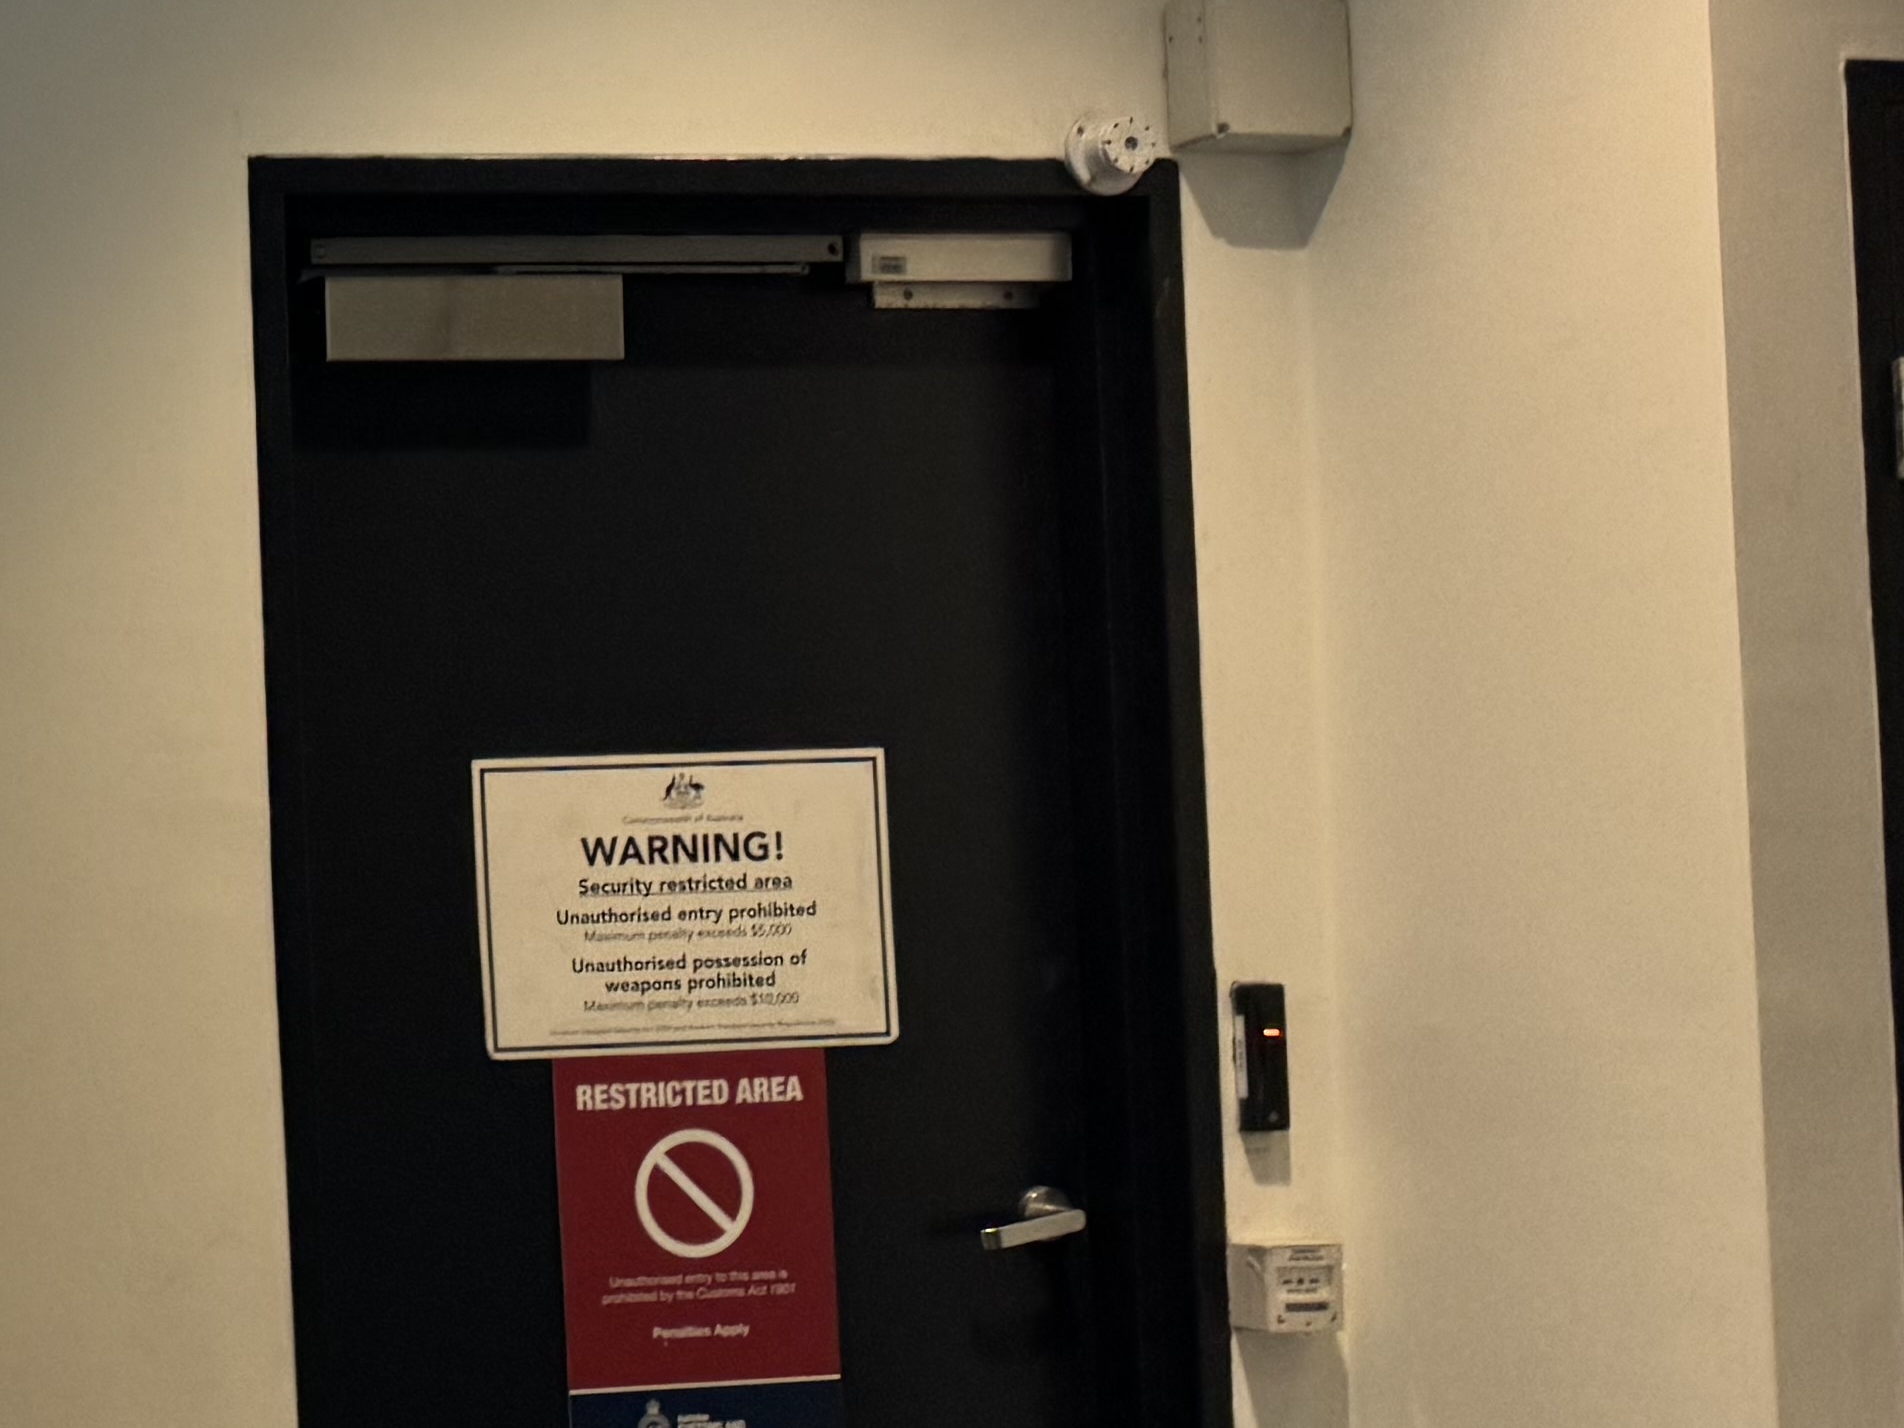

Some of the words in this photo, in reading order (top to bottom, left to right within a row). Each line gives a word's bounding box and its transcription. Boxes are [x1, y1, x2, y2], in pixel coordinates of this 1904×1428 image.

[580, 830, 785, 868] WARNING!
[578, 877, 654, 898] Security
[659, 872, 748, 892] restricted
[754, 875, 794, 890] area
[556, 905, 672, 925] Unauthorised
[677, 907, 724, 924] entry
[728, 900, 818, 922] prohibited
[571, 953, 687, 974] Unauthorised
[692, 951, 784, 972] possession
[789, 949, 808, 966] of
[604, 980, 682, 996] weapons
[687, 971, 776, 991] prohibited
[576, 1079, 730, 1111] RESTRICTED
[735, 1075, 804, 1104] AREA
